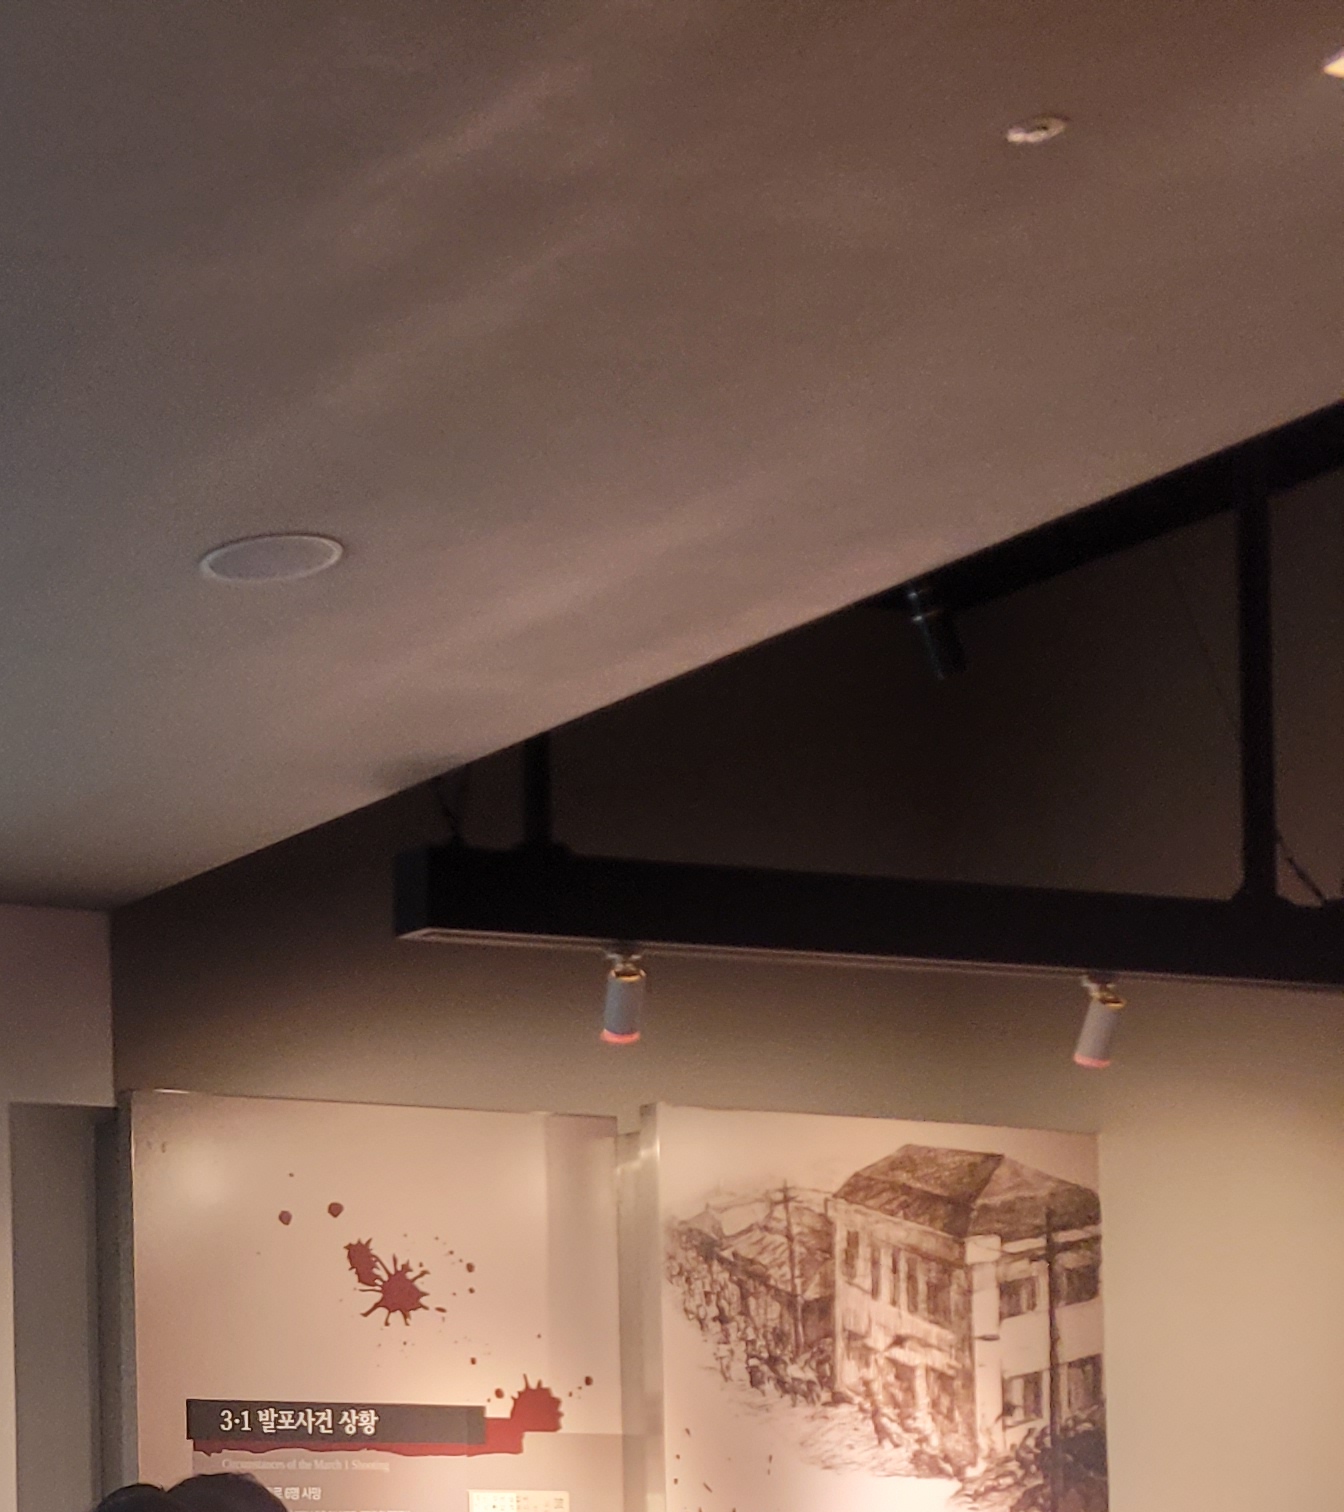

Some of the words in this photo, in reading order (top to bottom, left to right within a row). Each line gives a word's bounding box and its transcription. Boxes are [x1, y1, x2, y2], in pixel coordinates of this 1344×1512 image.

[256, 1407, 333, 1435] 발포사건
[337, 1408, 379, 1437] 상황
[286, 1458, 298, 1471] of
[298, 1458, 312, 1471] the
[313, 1458, 342, 1471] March
[351, 1458, 390, 1473] Shooting
[301, 1486, 322, 1501] 사망
